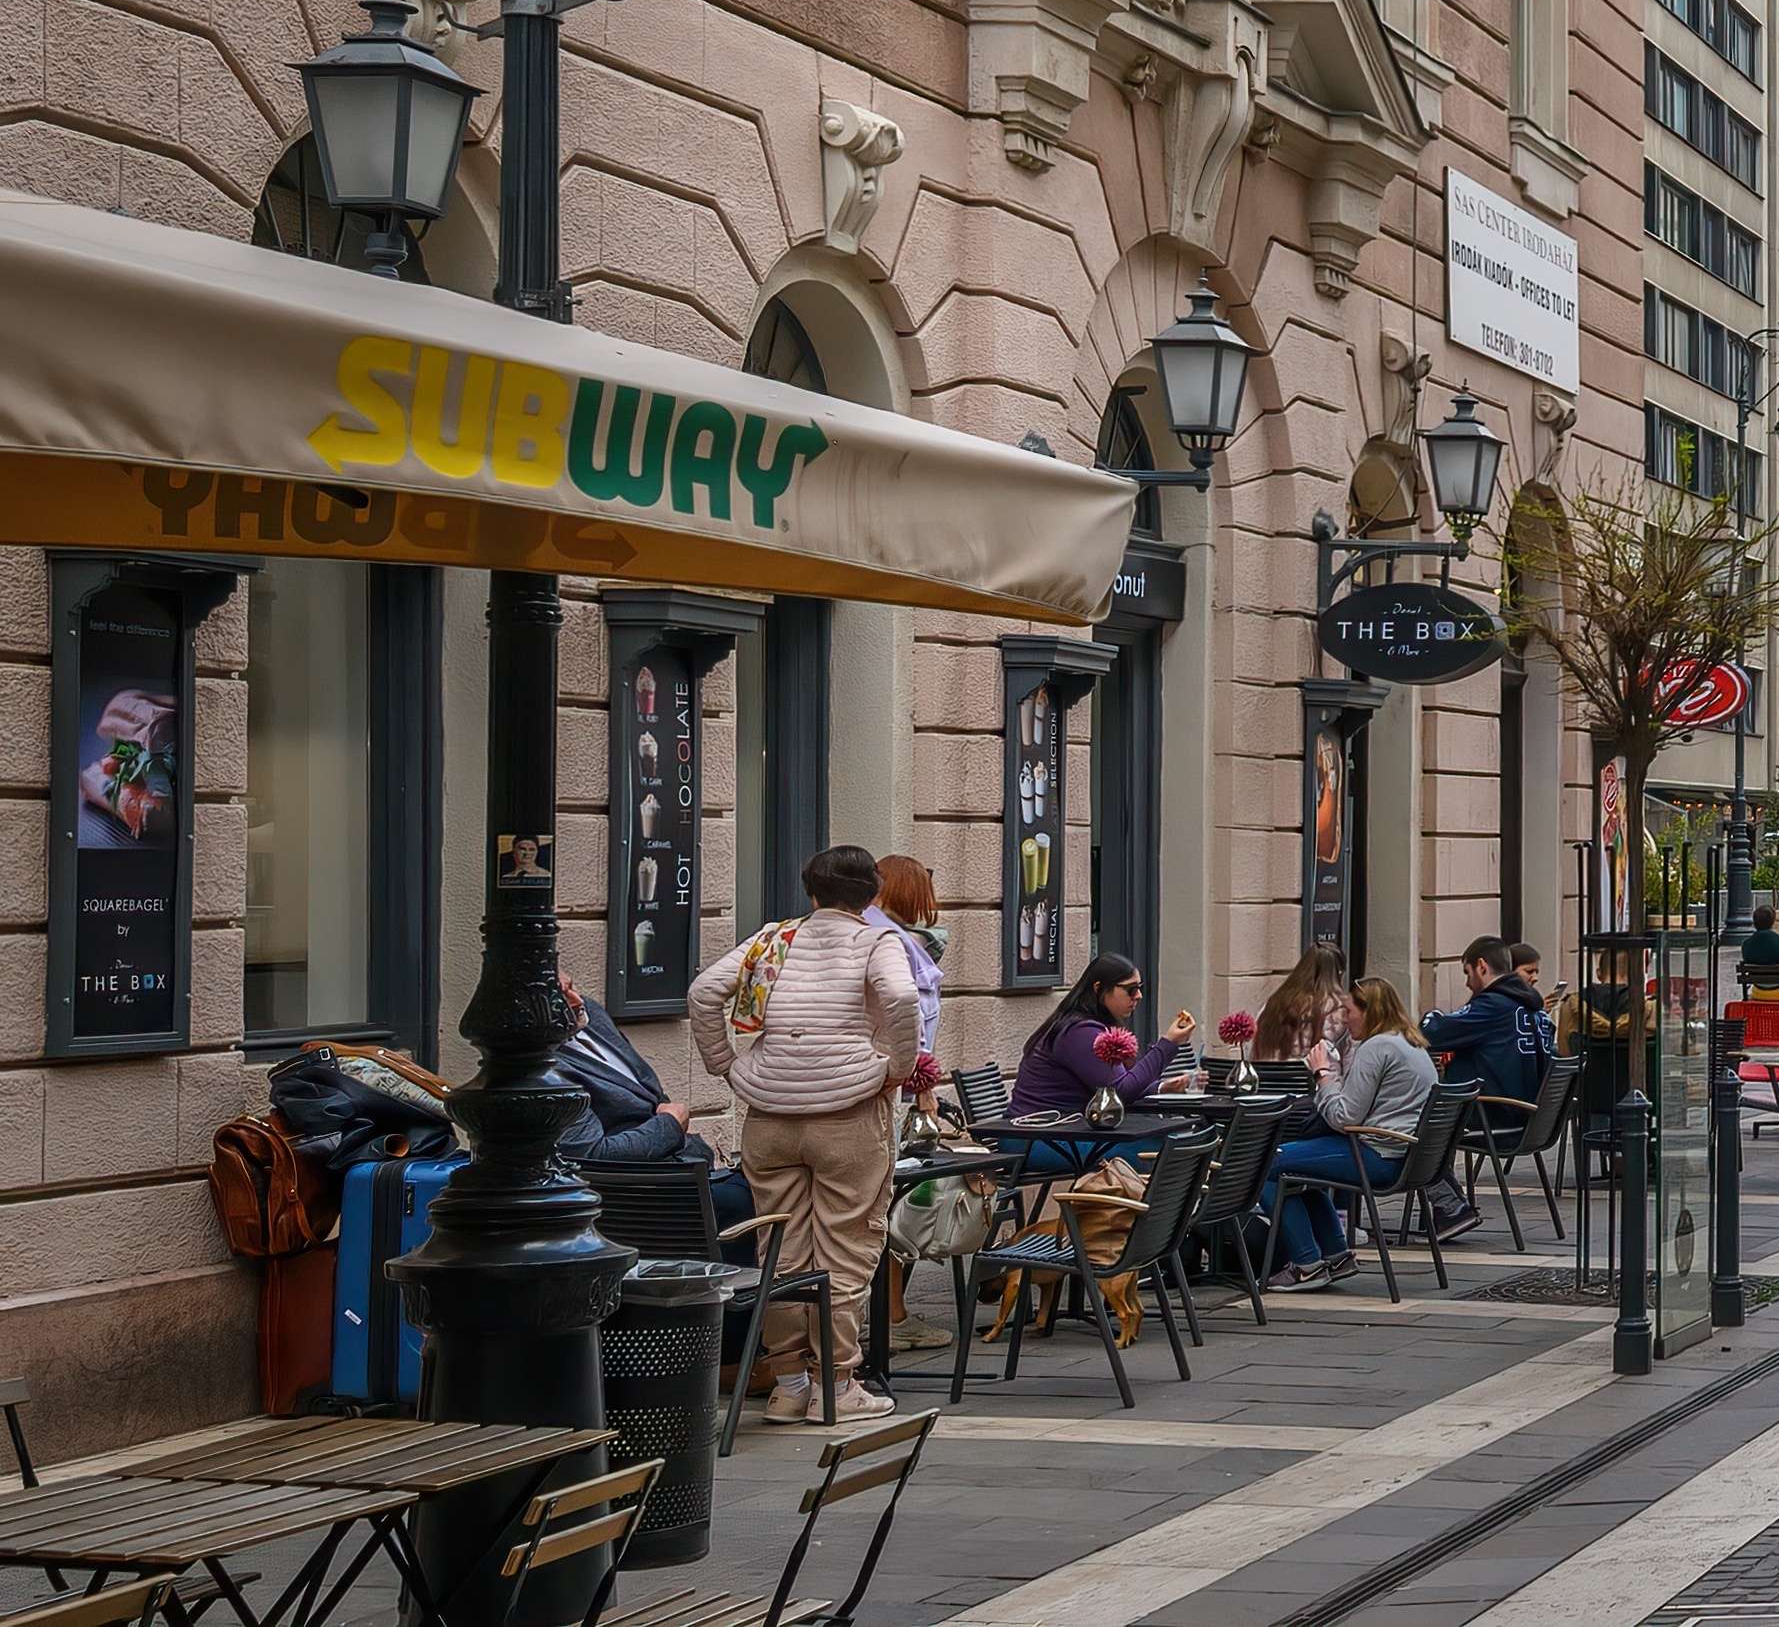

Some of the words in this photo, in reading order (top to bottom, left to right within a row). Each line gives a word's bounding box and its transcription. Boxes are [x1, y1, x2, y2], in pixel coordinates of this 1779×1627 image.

[1455, 185, 1476, 220] SAS
[1477, 199, 1521, 245] CENTER
[1520, 275, 1551, 311] OFFICES
[1552, 292, 1562, 316] TO
[1563, 297, 1576, 323] LET
[306, 335, 829, 531] SUBWAY
[1113, 571, 1146, 598] onut
[1337, 621, 1395, 640] THE
[1415, 620, 1475, 641] BOX
[675, 681, 692, 826] HOCOLATE
[675, 853, 691, 906] HOT
[82, 899, 165, 912] SQUAREBAGEL
[117, 924, 130, 938] by
[81, 975, 119, 992] THE
